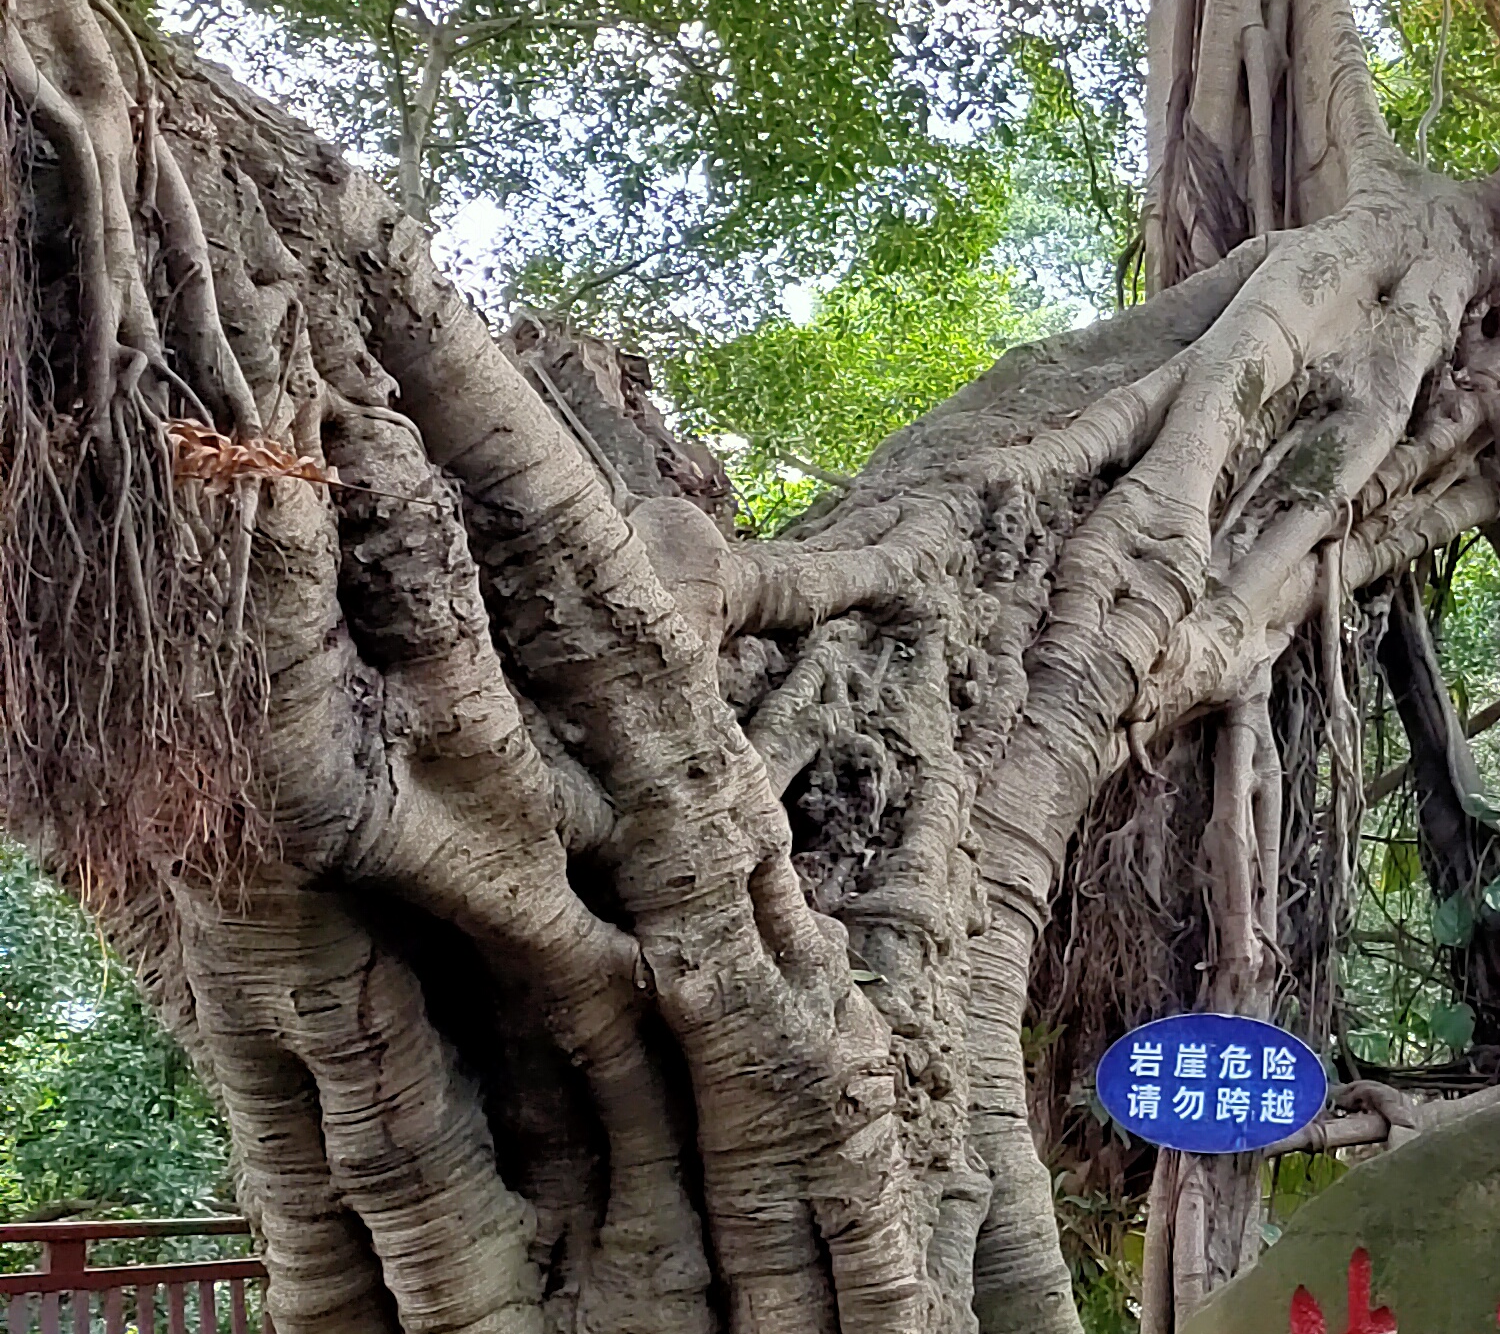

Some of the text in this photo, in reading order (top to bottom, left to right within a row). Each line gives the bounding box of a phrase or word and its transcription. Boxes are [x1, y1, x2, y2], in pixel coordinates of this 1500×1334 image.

[1129, 1042, 1297, 1081] 岩崖危险
[1127, 1084, 1295, 1124] 请勿跨越
